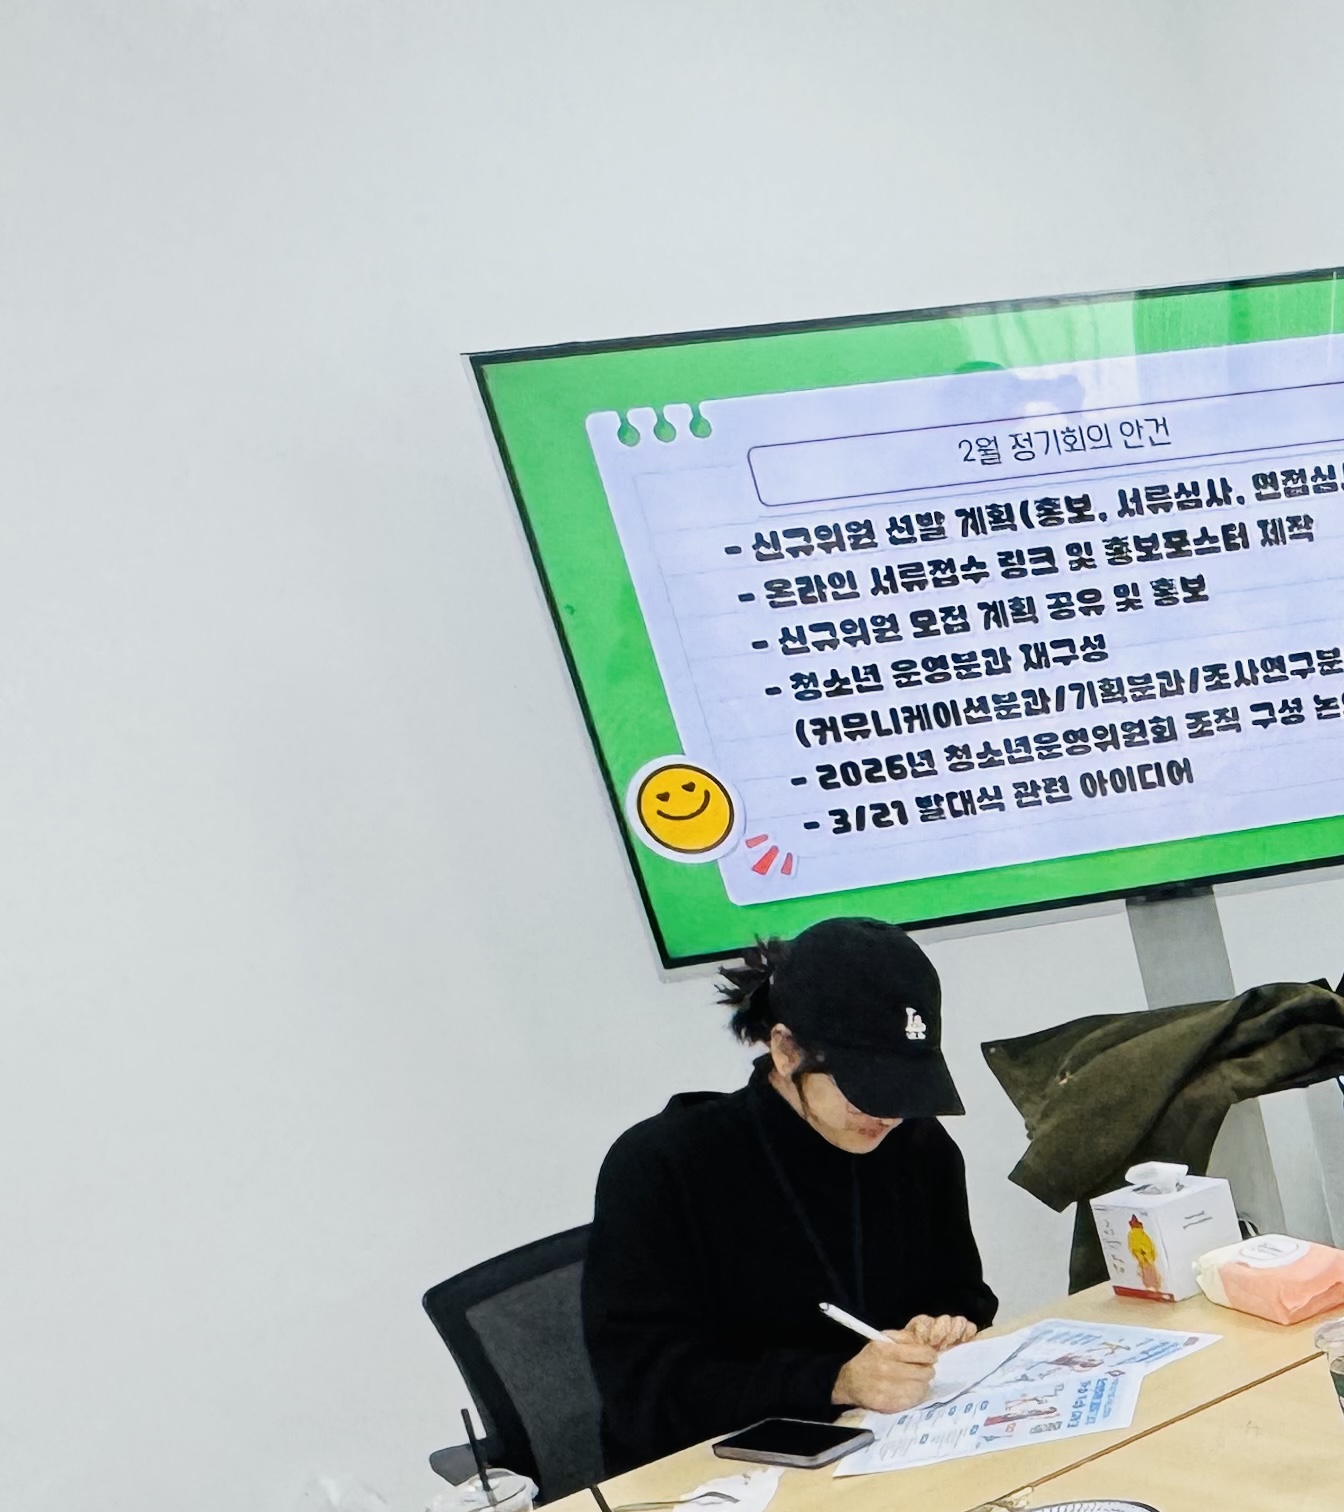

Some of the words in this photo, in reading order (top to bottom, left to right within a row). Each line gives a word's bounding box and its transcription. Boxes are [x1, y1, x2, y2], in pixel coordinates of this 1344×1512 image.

[959, 437, 1002, 465] 2월
[1008, 423, 1112, 462] 정기회의
[1118, 416, 1172, 449] 안건
[752, 518, 878, 562] 신규위원
[886, 511, 948, 546] 선발
[764, 570, 861, 609] 온라인
[870, 555, 990, 597] 서류접수
[997, 546, 1060, 580] 링크
[1065, 541, 1098, 572] 및
[1102, 522, 1250, 567] 홍보포스터
[1256, 513, 1315, 548] 제작
[778, 613, 903, 656] 신규위원
[909, 604, 971, 639] 모집
[977, 595, 1039, 631] 계획
[1045, 588, 1105, 621] 공유
[1113, 581, 1143, 612] 및
[1150, 573, 1210, 607] 홍보
[790, 663, 884, 701] 청소년
[890, 646, 1012, 689] 운영분과
[1018, 633, 1109, 672] 재구성
[816, 748, 939, 790] 2026년
[943, 715, 1179, 773] 청소년운영위원회
[1186, 706, 1242, 740] 조직
[1250, 697, 1306, 730] 구성
[828, 800, 909, 835] 3/21
[915, 785, 1006, 823] 발대식
[1012, 775, 1073, 809] 관련
[1079, 757, 1194, 799] 아이디어
[905, 1006, 927, 1040] LA
